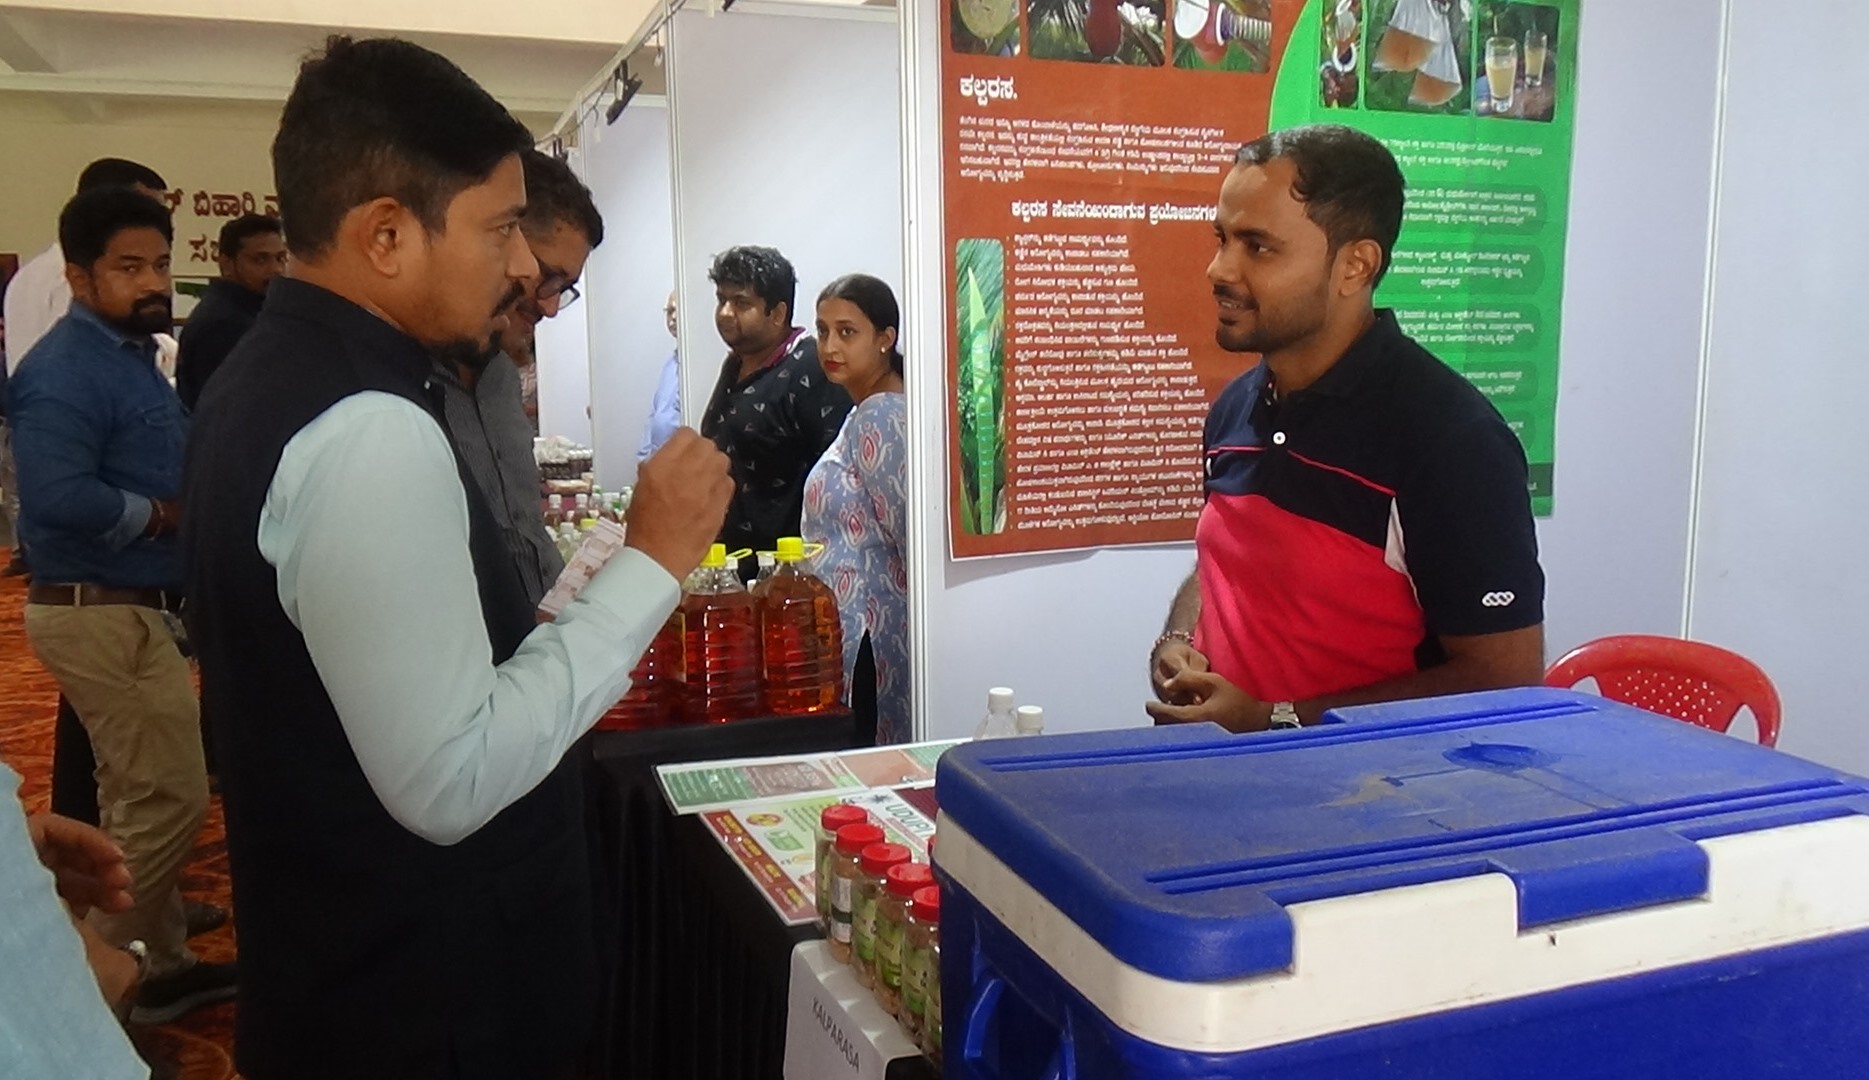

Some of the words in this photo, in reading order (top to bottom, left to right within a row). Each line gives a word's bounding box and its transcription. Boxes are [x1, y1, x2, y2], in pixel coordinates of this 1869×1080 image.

[960, 74, 1018, 106] ಕಲ್ಪರಸ.
[193, 190, 256, 217] ಬಿಹಾರಿ
[1011, 200, 1048, 223] ಕಲ್ಪರಸ
[885, 803, 935, 837] UDUPI
[812, 996, 861, 1072] KALPARASA
